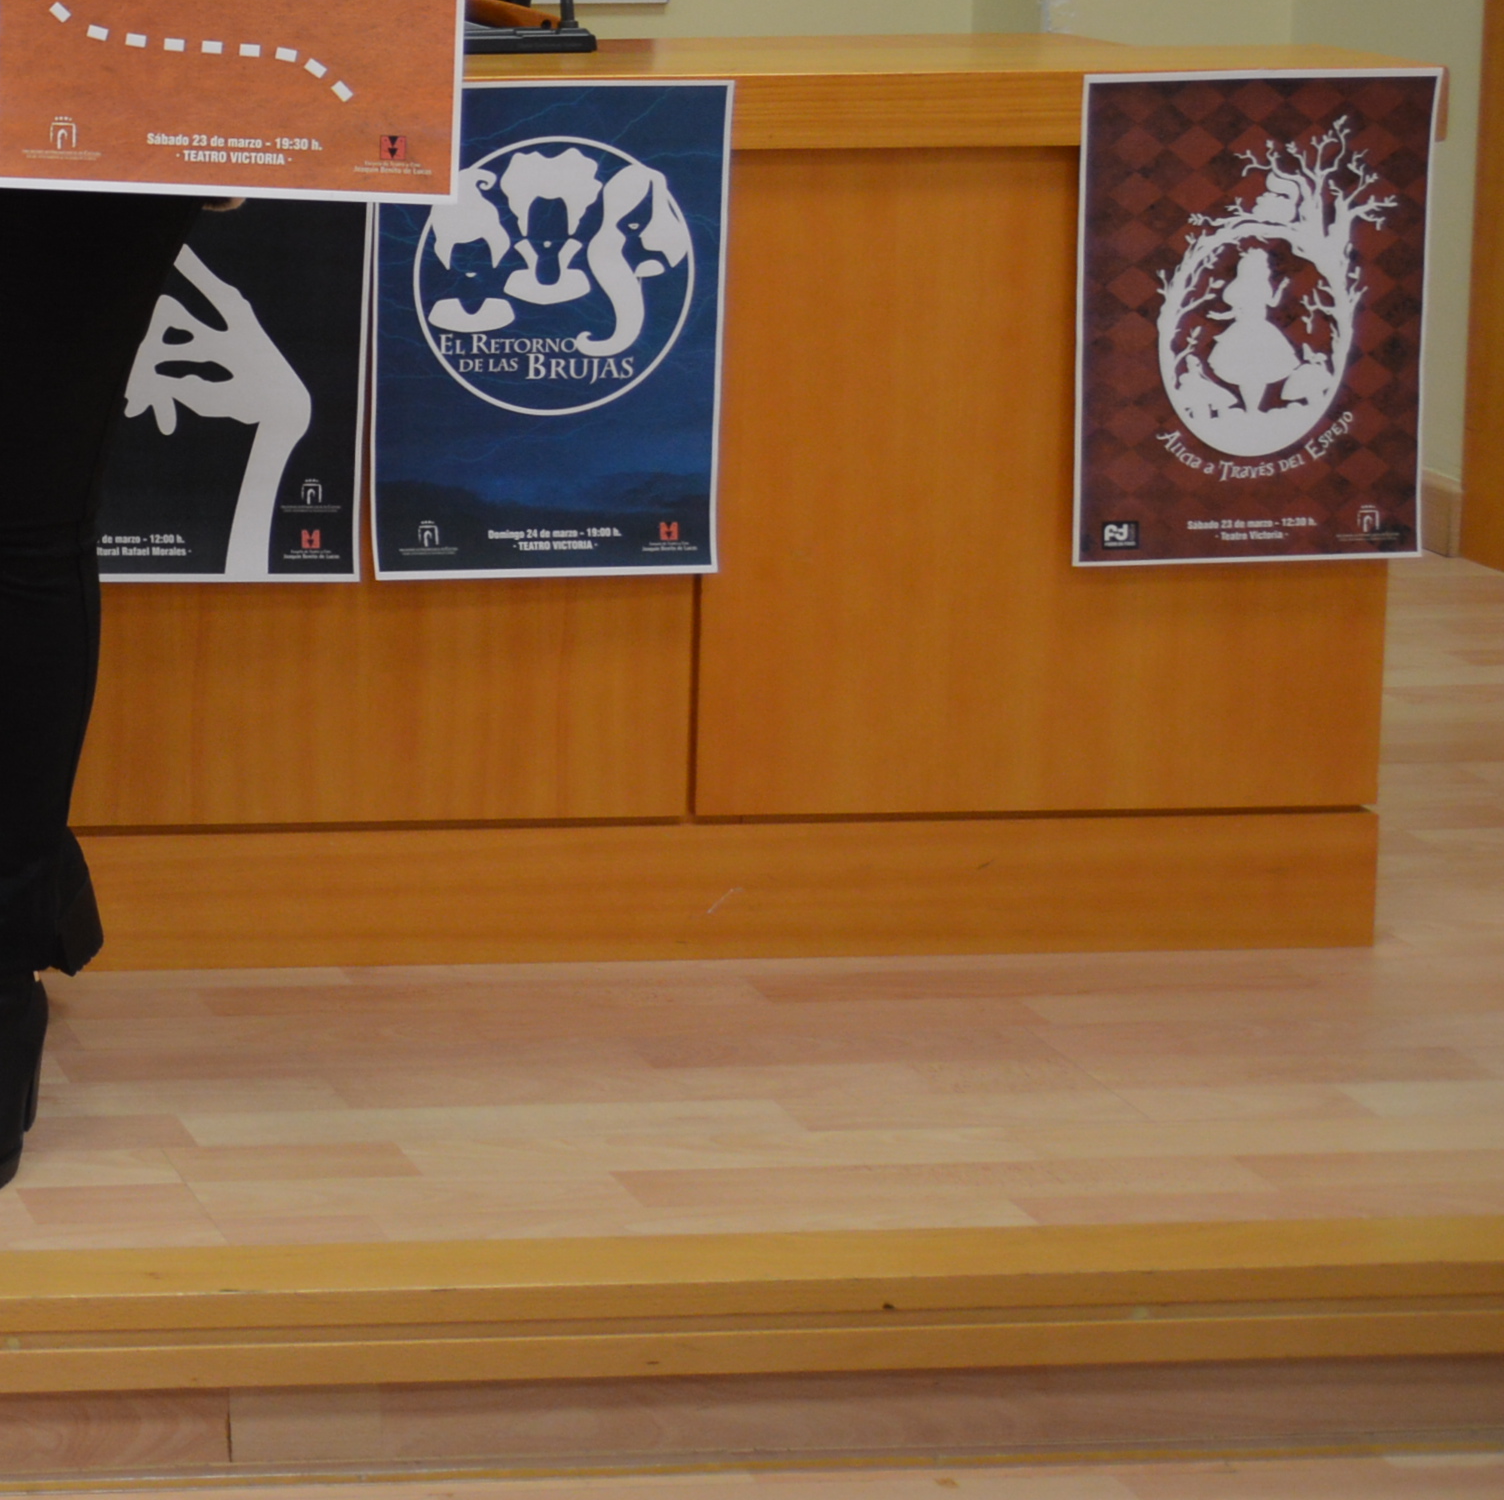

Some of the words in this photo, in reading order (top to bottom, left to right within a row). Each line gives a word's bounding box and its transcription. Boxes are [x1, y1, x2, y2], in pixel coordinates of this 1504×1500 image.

[146, 132, 190, 146] Sábado
[192, 134, 208, 147] 23
[210, 135, 225, 147] de
[227, 137, 263, 149] marzo
[274, 137, 309, 150] 19:30
[311, 139, 323, 151] h.
[183, 149, 228, 163] TEATRO
[230, 151, 286, 165] VICTORIA
[458, 358, 484, 373] DE
[487, 357, 519, 373] LAS
[101, 534, 113, 544] de
[114, 535, 141, 544] marzo
[149, 534, 175, 544] 12:00
[539, 528, 551, 539] de
[121, 546, 150, 556] Rafael
[151, 546, 187, 556] Morales
[518, 540, 551, 551] TEATRO
[552, 540, 593, 551] VICTORIA
